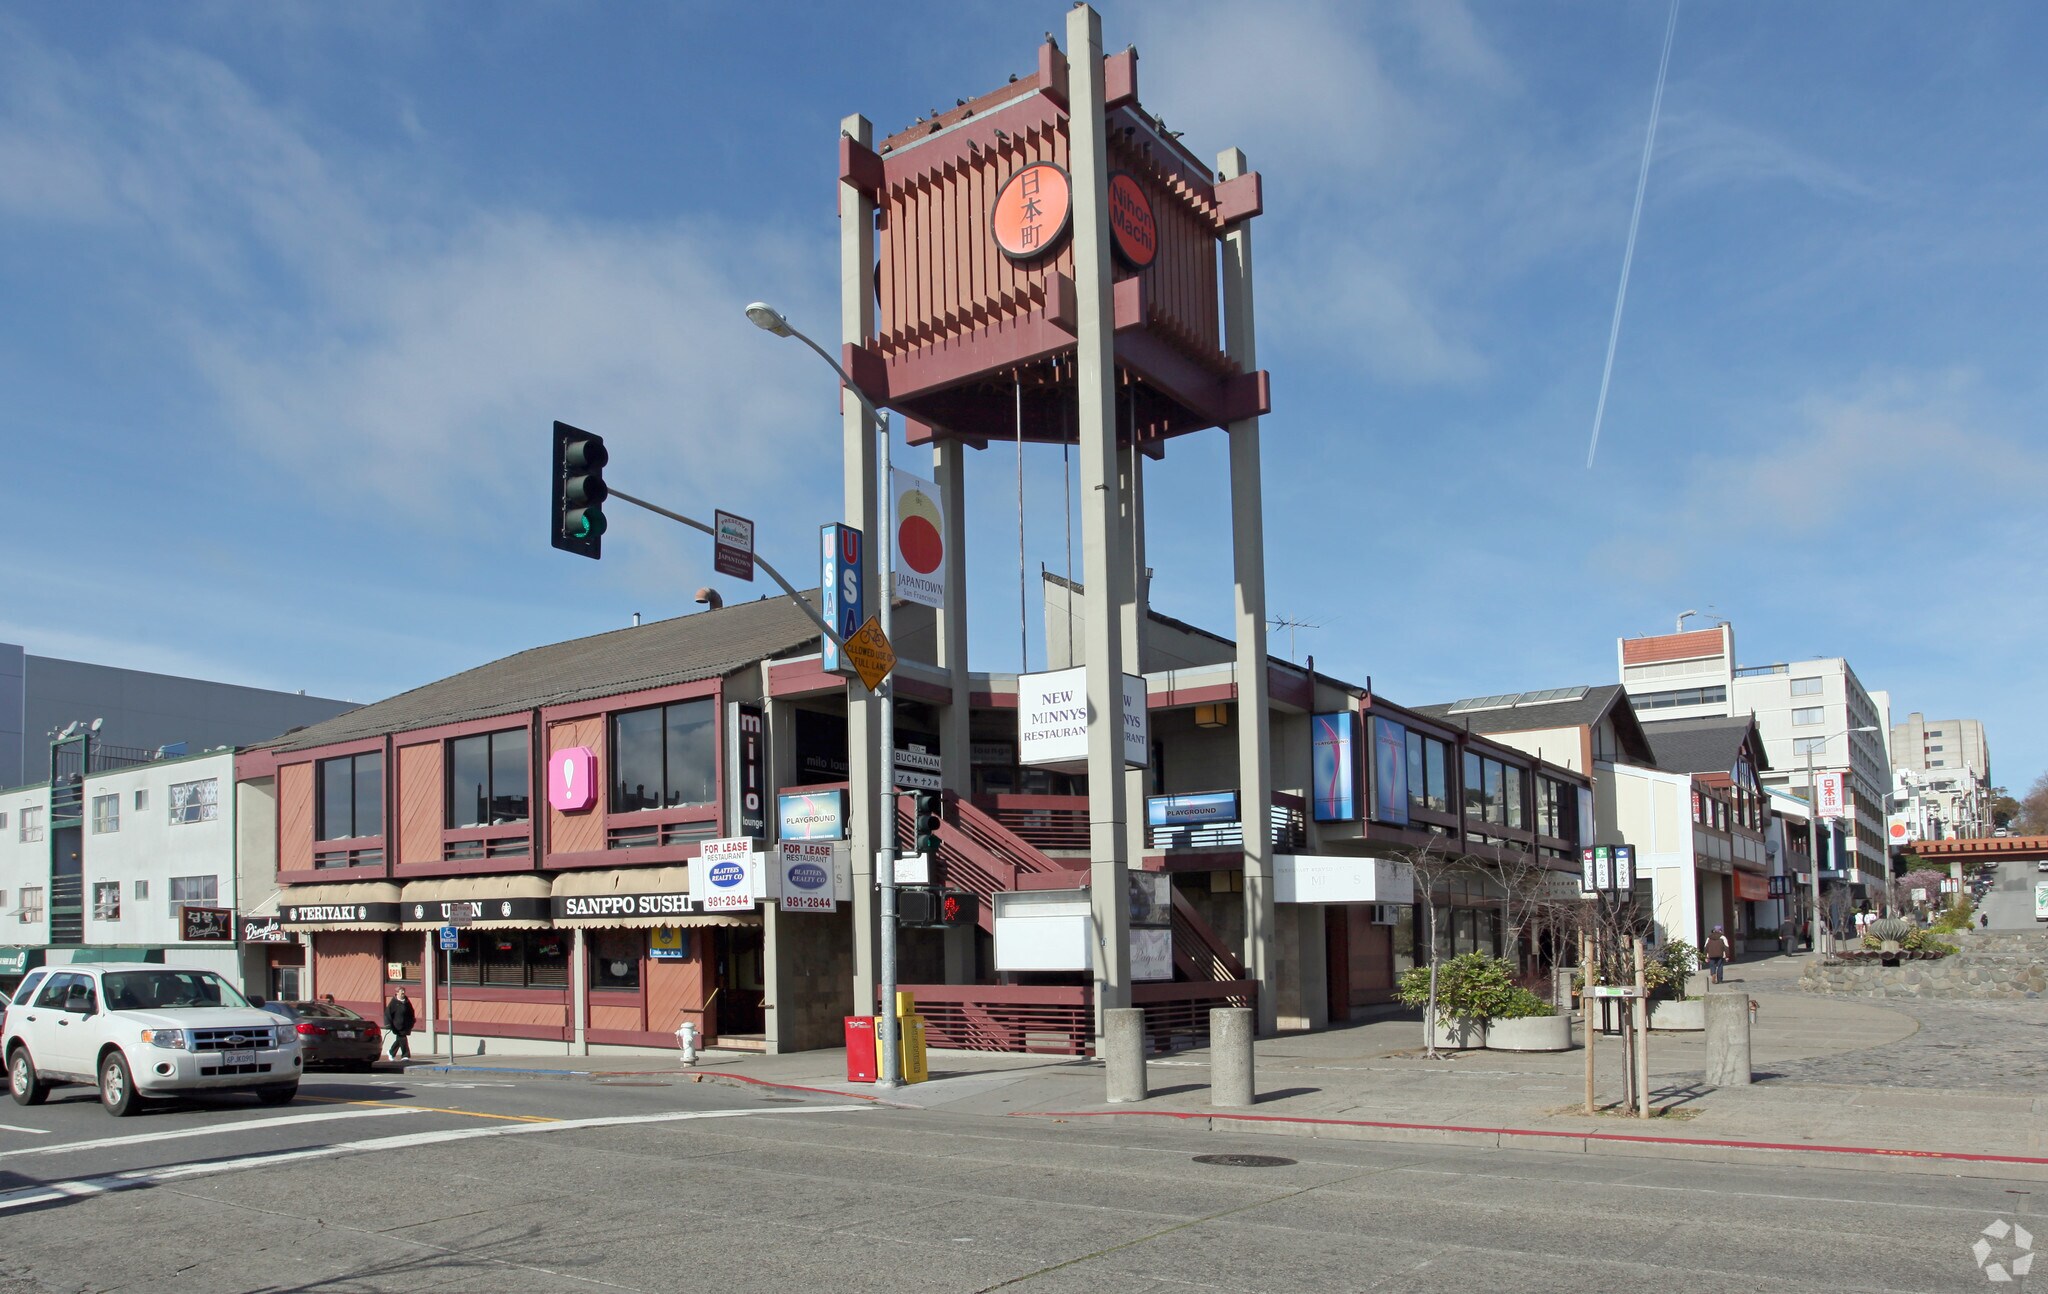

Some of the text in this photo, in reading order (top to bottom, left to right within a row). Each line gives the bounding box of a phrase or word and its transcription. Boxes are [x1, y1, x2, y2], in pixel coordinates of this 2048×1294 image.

[1020, 169, 1042, 249] 日本町
[1112, 183, 1152, 229] Nihon
[1113, 204, 1152, 251] Machi
[721, 518, 749, 533] PRESERVE
[721, 534, 748, 546] AMERICA
[718, 552, 751, 567] JAPANTOWN
[824, 534, 834, 615] USA
[897, 573, 943, 595] JAPANTOWN
[903, 588, 938, 604] San Francisco
[848, 644, 894, 662] ALLOWED USE OF
[855, 657, 887, 673] FULL LANE
[1042, 690, 1073, 705] NEW
[1032, 707, 1086, 725] MINNYS
[1024, 725, 1088, 741] RESTAURAN
[1314, 739, 1349, 747] PLAYGROUND
[974, 746, 1010, 756] lounge
[741, 714, 760, 810] milo
[806, 756, 827, 768] milo
[895, 752, 940, 767] BUCHANAN
[1824, 779, 1835, 806] 日本街
[1167, 807, 1217, 816] PLAYGROUND
[743, 816, 763, 829] lounge
[786, 814, 836, 825] PLAYGROUND
[704, 842, 748, 854] FOR LEASE
[783, 843, 830, 856] FOR LEASE
[707, 852, 745, 862] RESTAURANT
[786, 853, 828, 863] RESTAURANT
[711, 874, 733, 882] REALTY
[713, 866, 739, 875] BLATTEIS
[793, 868, 822, 876] BLATTEIS
[1598, 863, 1606, 883] かえる
[791, 875, 813, 883] REALTY
[441, 902, 482, 918] UN
[566, 894, 694, 915] SANPPO SUSHI
[299, 905, 355, 921] TERIYAKI
[187, 922, 219, 938] Dimples
[245, 918, 279, 940] Dimples
[1134, 949, 1167, 965] Pagoda
[390, 968, 401, 978] OPEN
